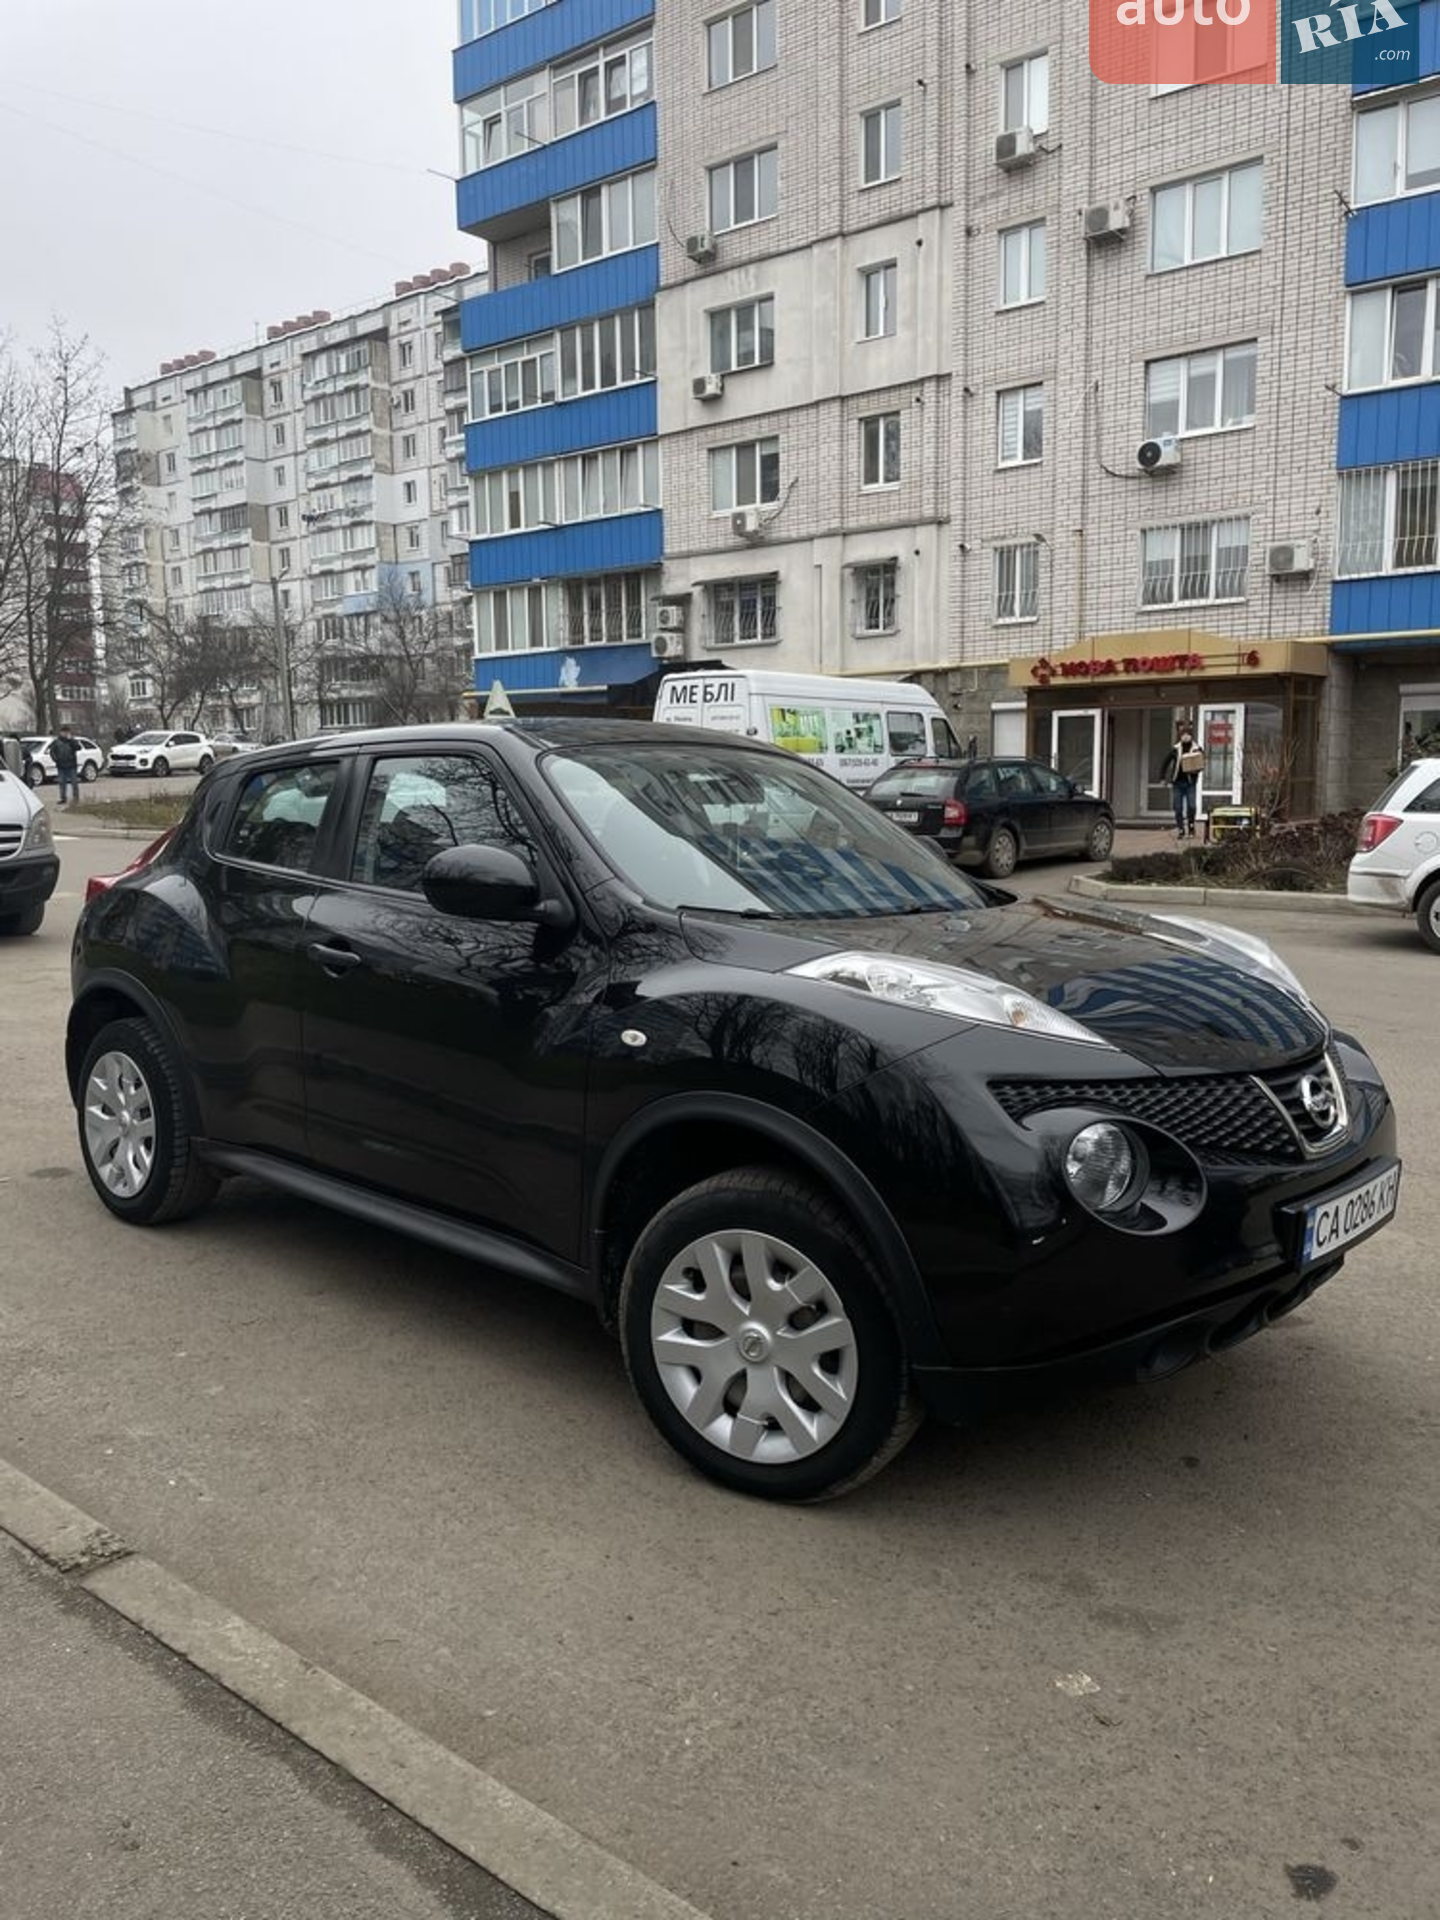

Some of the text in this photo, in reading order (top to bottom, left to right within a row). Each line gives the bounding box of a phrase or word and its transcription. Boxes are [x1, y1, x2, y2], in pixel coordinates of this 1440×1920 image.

[1121, 653, 1203, 674] ПОШТА
[1316, 1205, 1339, 1248] CA
[1343, 1184, 1377, 1234] 0286
